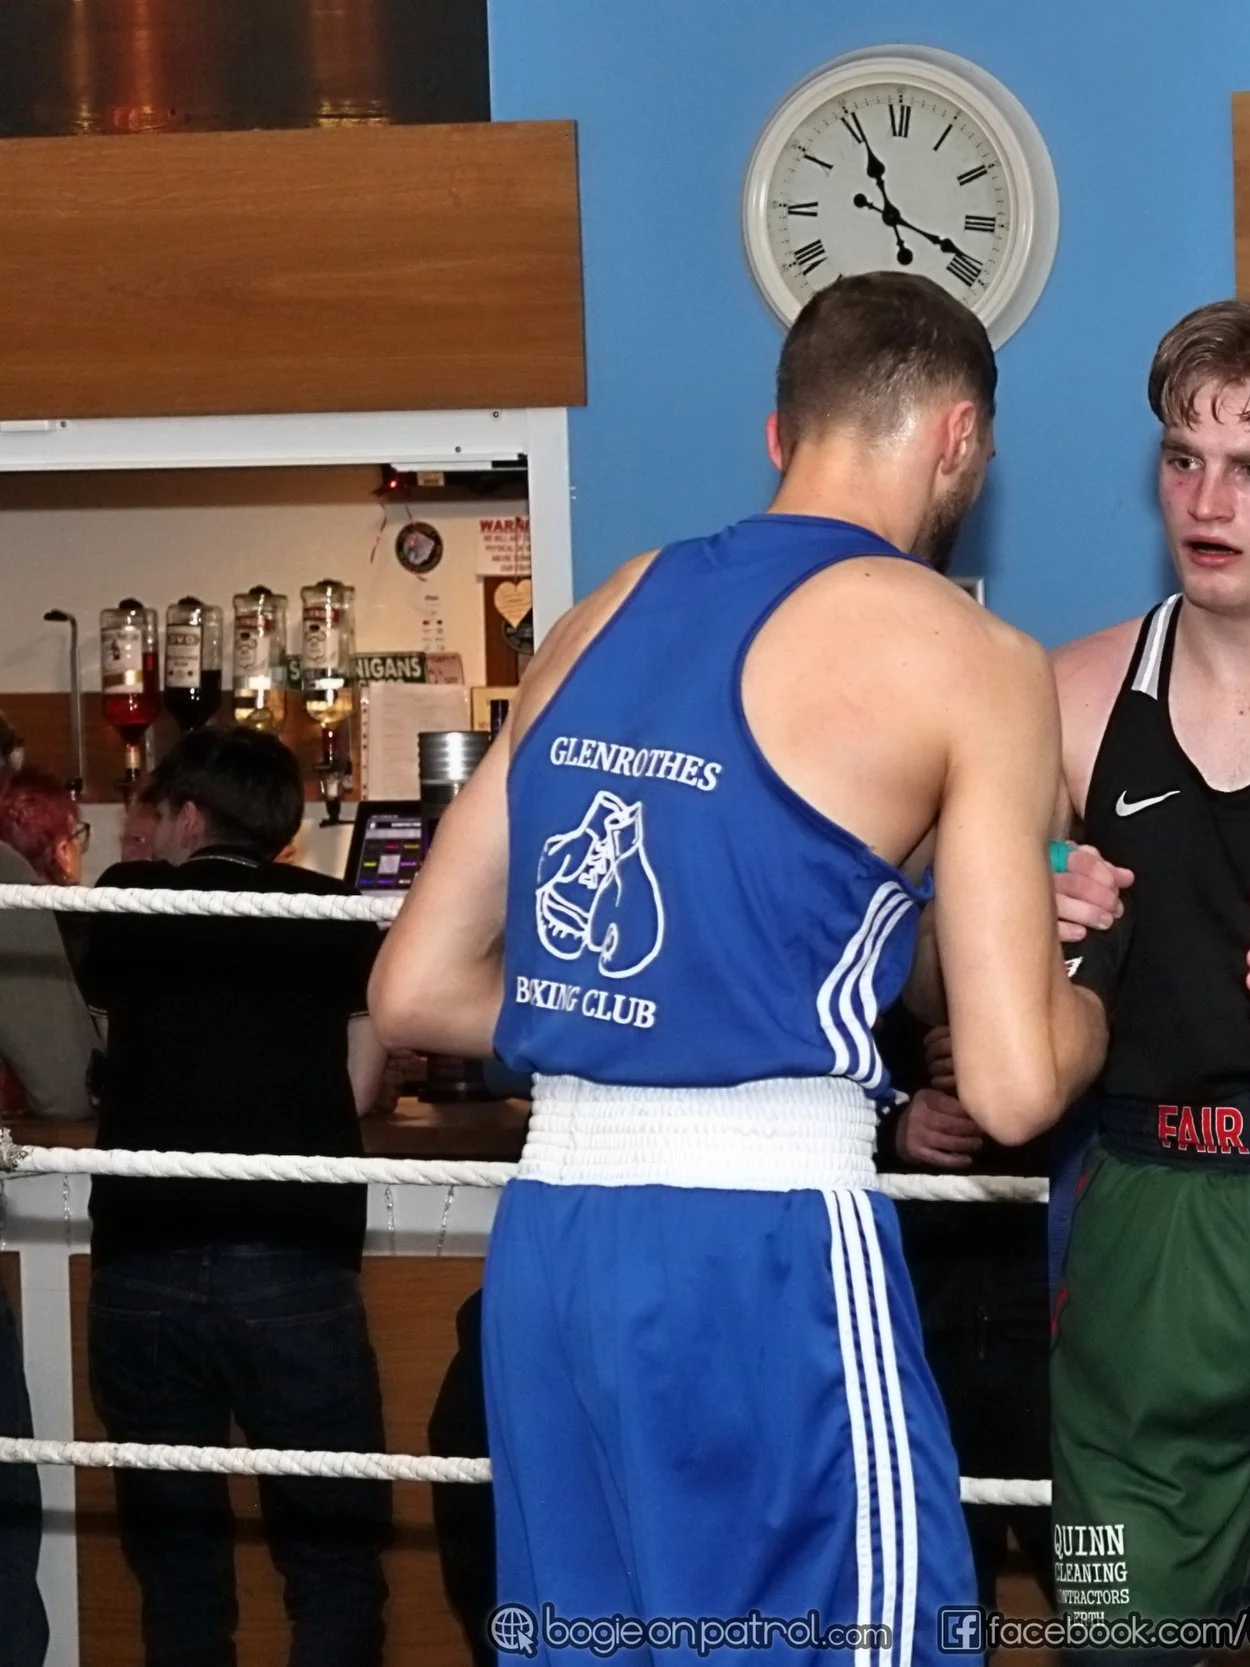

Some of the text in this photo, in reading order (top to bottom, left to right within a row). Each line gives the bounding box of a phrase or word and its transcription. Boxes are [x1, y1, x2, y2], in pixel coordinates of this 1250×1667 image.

[550, 736, 722, 792] GLENROTHES
[581, 989, 657, 1029] CLUB
[1157, 1104, 1250, 1155] FAIR
[1054, 1524, 1125, 1560] QUINN
[1054, 1562, 1128, 1583] CLEANING
